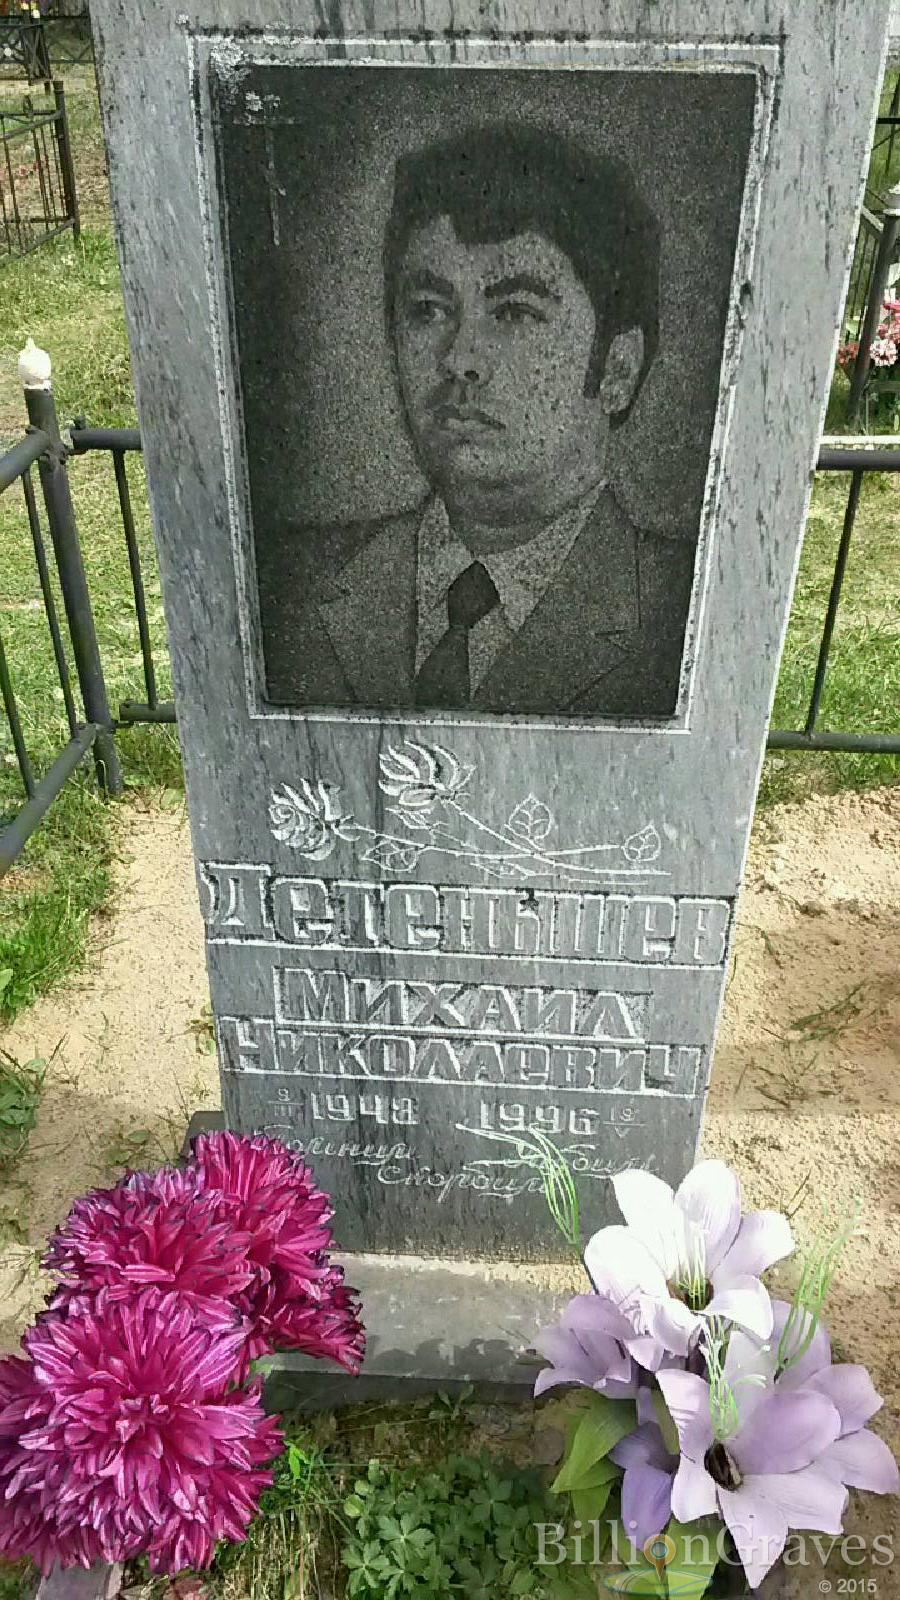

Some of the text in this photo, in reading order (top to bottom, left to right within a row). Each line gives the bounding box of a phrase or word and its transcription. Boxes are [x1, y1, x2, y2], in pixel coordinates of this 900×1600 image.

[276, 967, 642, 1038] МИХАИЛ
[310, 1092, 420, 1125] 1948
[480, 1099, 600, 1136] 1996
